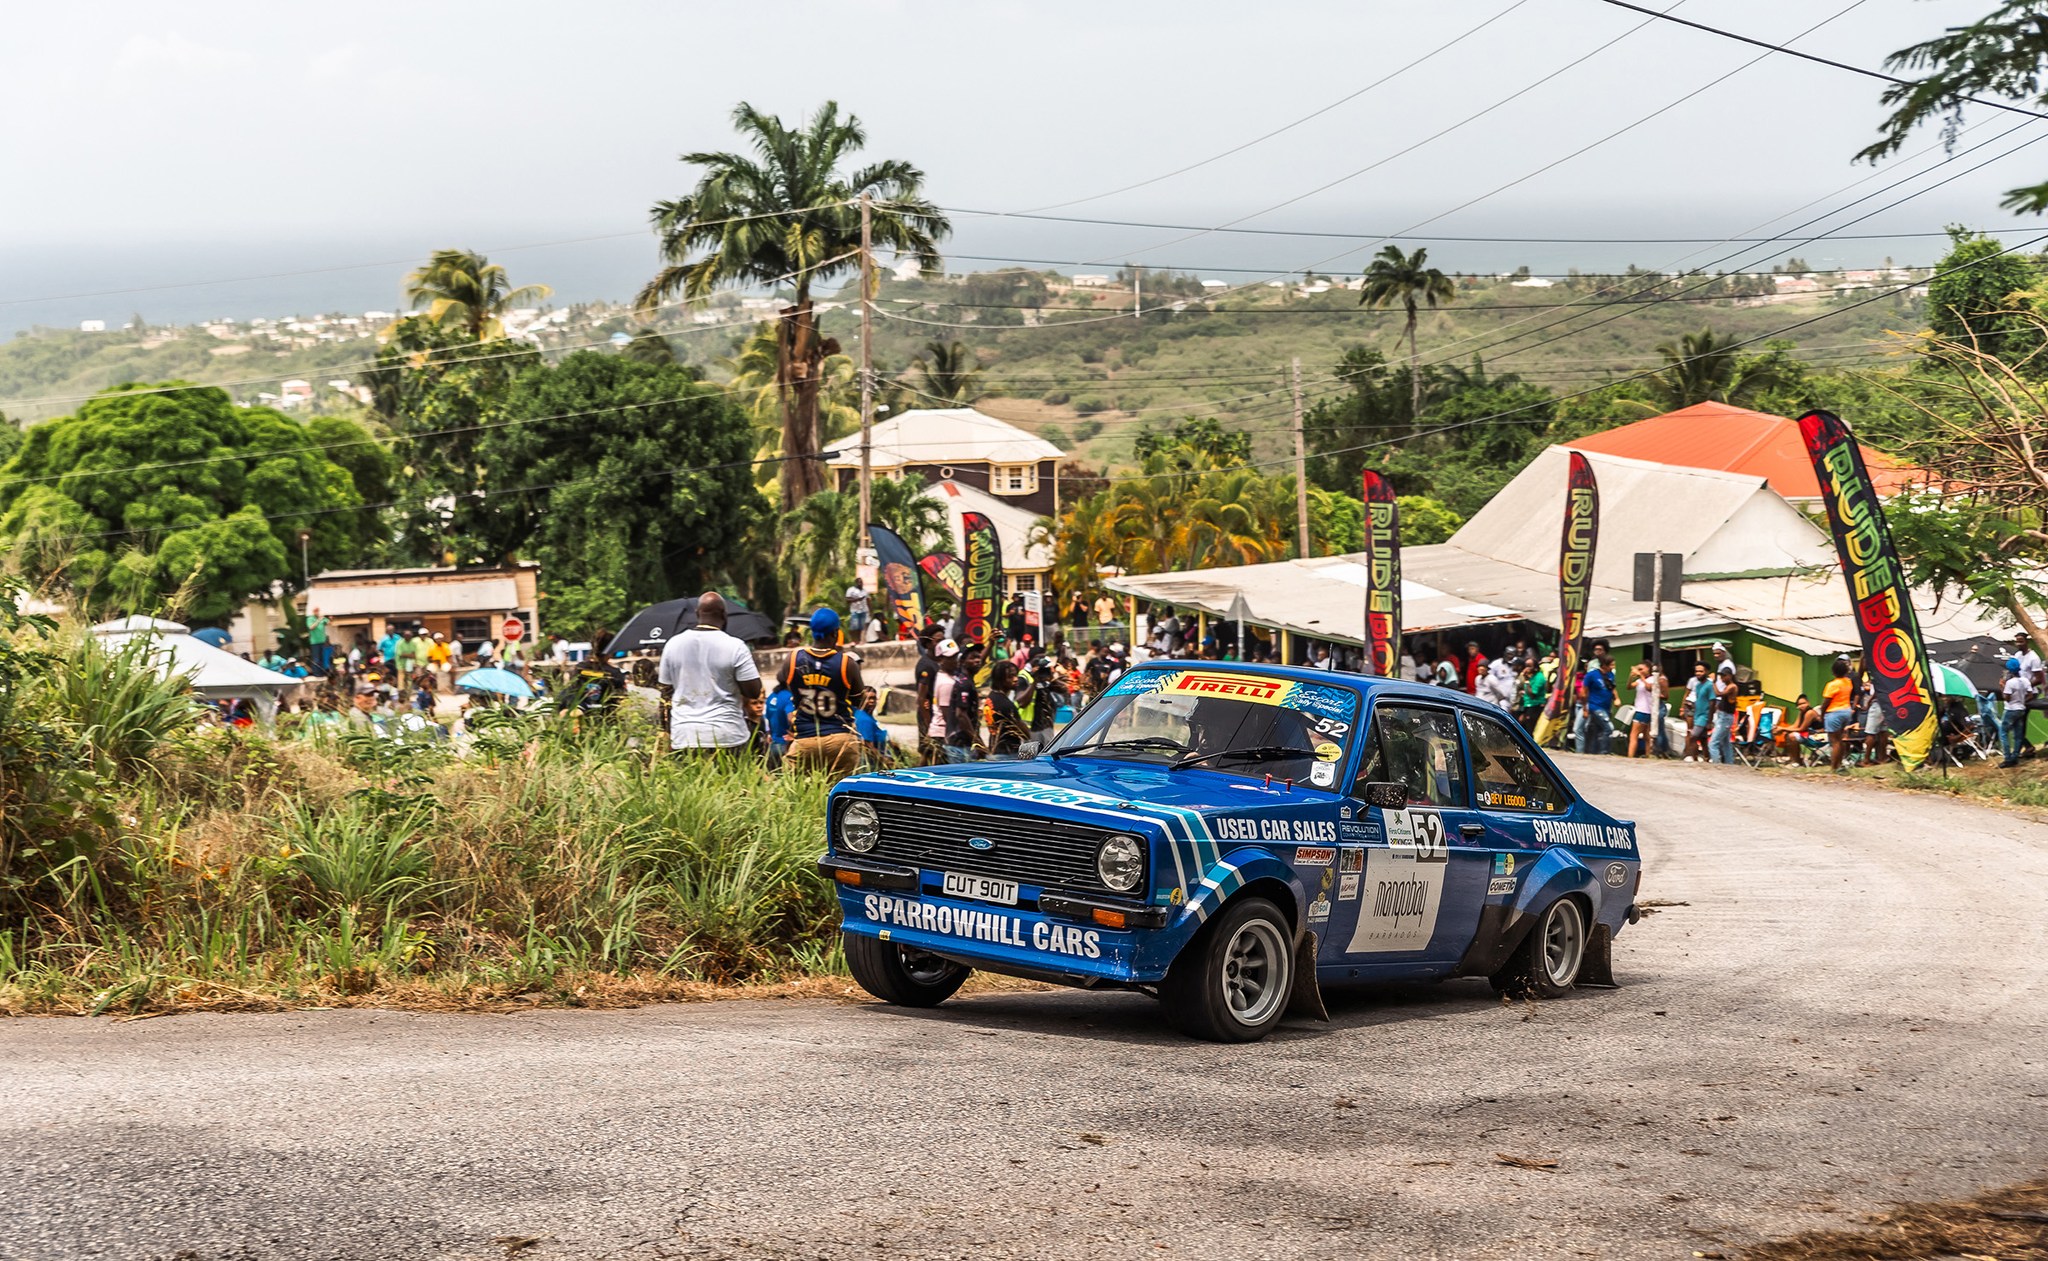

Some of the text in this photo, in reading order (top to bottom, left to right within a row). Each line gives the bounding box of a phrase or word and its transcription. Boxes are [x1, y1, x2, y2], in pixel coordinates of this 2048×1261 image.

[965, 527, 994, 650] RUDEBO
[1368, 502, 1394, 678] RUDEBO
[1176, 674, 1282, 699] PIRELLI
[1299, 690, 1344, 707] Escort
[798, 688, 837, 718] 30
[1314, 717, 1349, 739] 52
[1491, 793, 1503, 805] BEV
[1217, 817, 1337, 842] USED CAR SALES
[1341, 824, 1379, 834] REVOLUTION
[1411, 814, 1447, 858] 52
[1532, 818, 1632, 850] SPARROWHILL CARS
[1296, 848, 1332, 859] SIMPSON
[1607, 865, 1627, 884] Ford
[947, 875, 1015, 902] CUT 901T
[864, 894, 1101, 959] SPARROWHILL CARS
